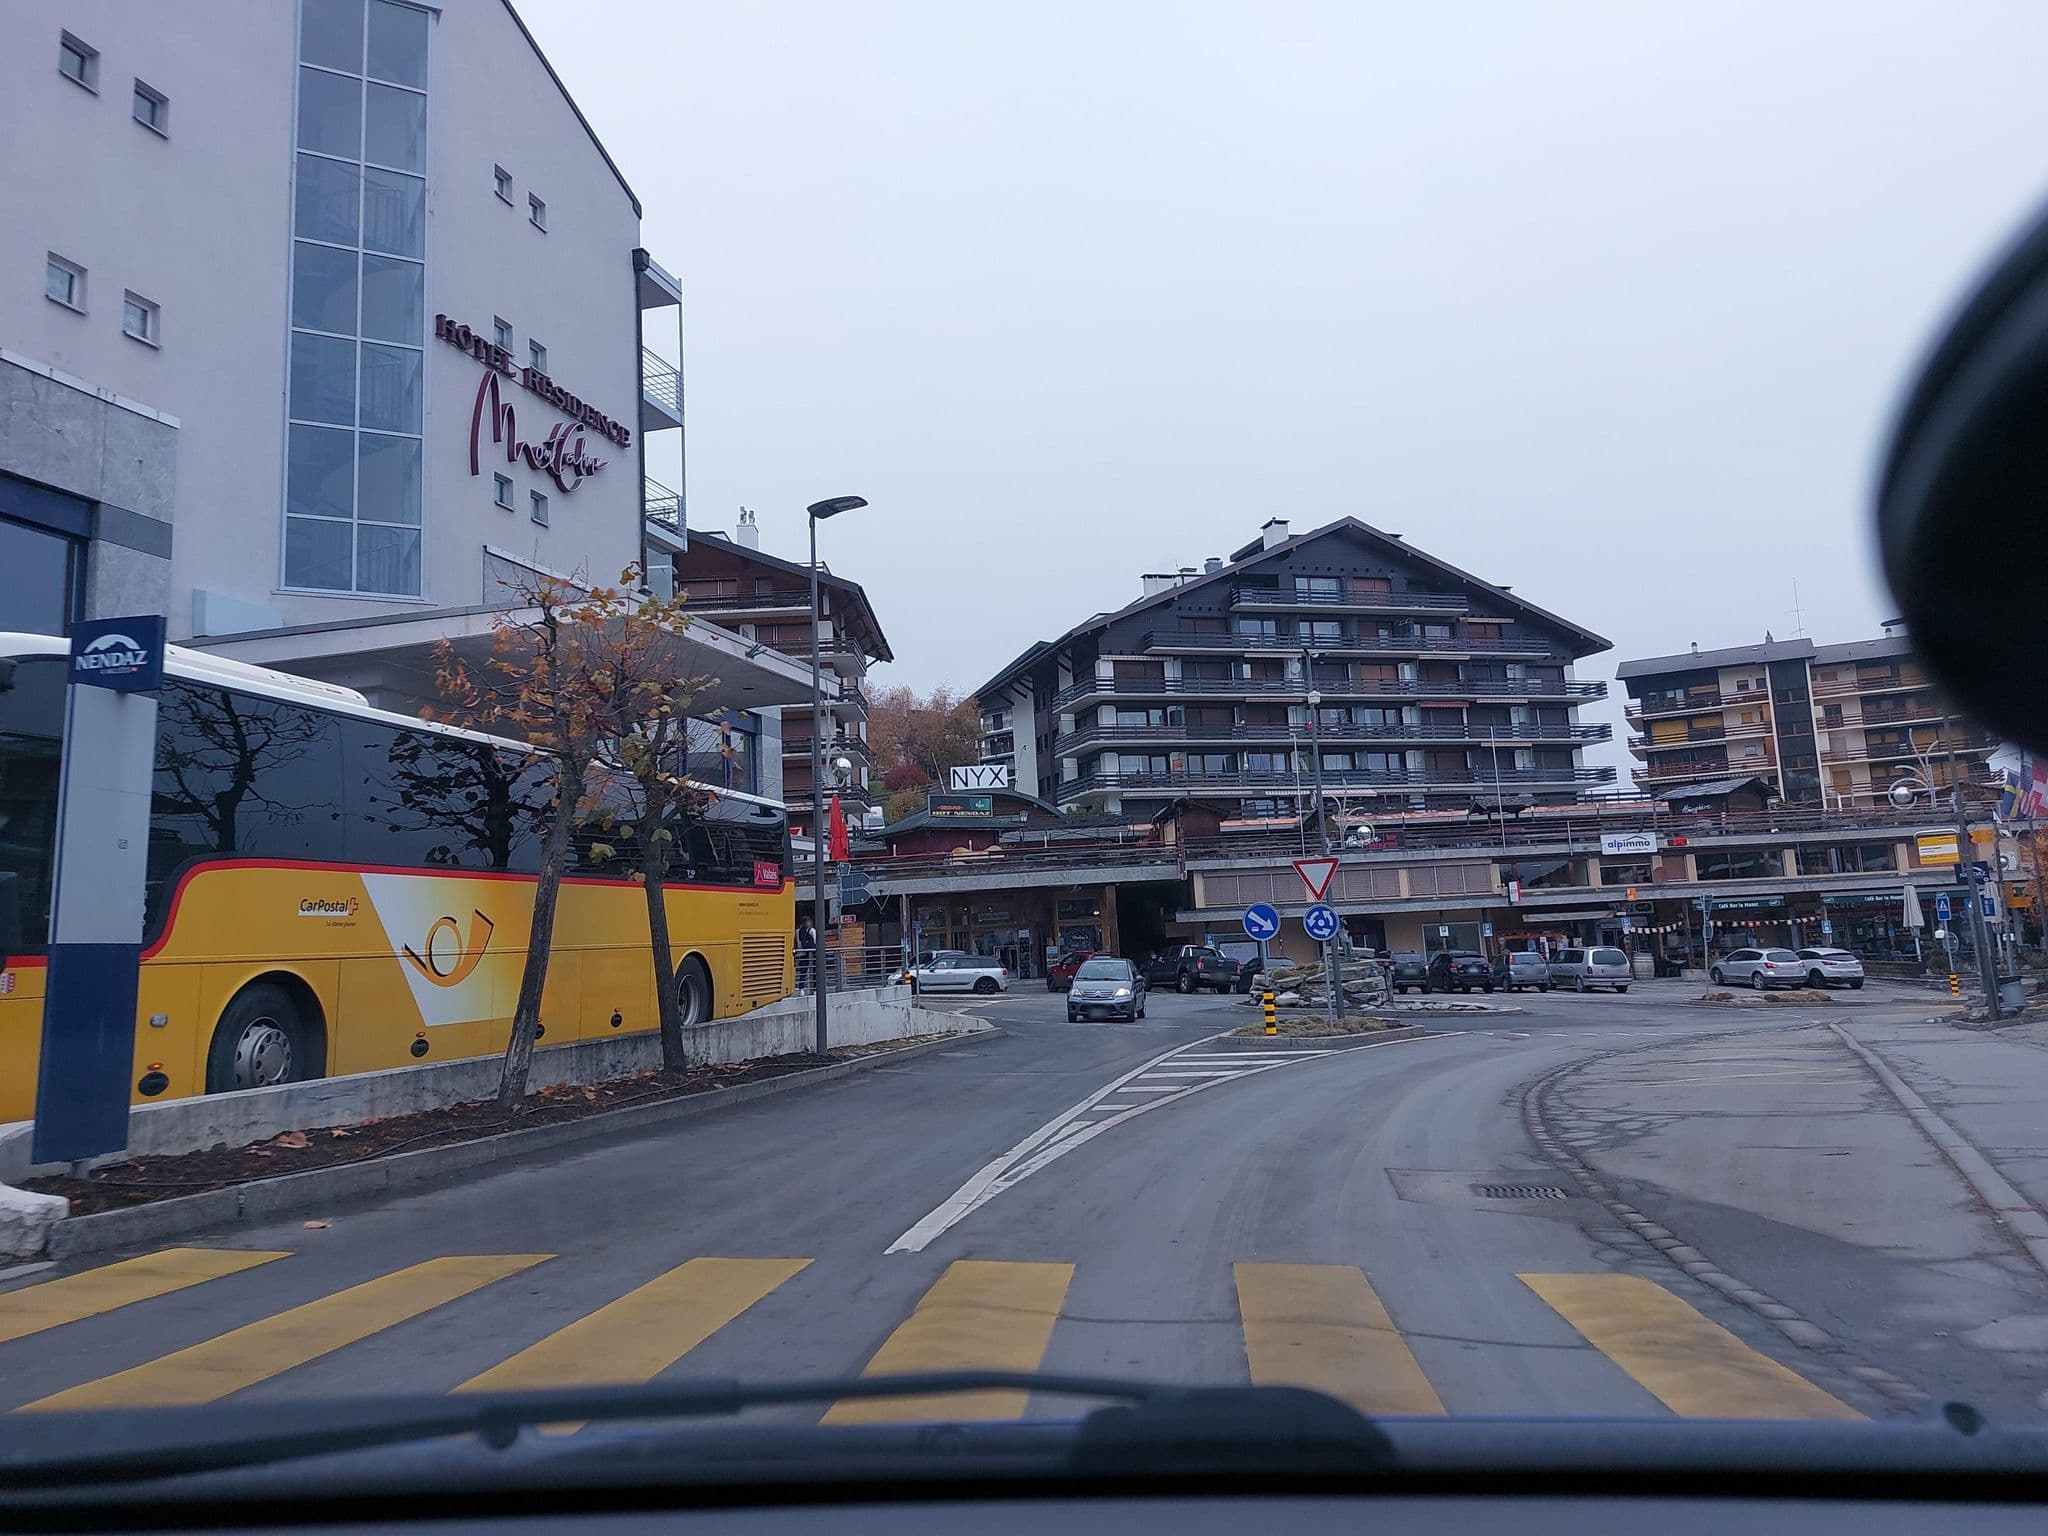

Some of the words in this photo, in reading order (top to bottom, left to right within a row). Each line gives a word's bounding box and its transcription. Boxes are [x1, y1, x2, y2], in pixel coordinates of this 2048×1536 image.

[435, 313, 517, 378] HÔTEL
[75, 650, 149, 671] NENDAZ
[953, 766, 1006, 788] NYX
[1607, 839, 1651, 852] alpimmo
[762, 868, 778, 880] Valais
[300, 898, 349, 913] CarPostal
